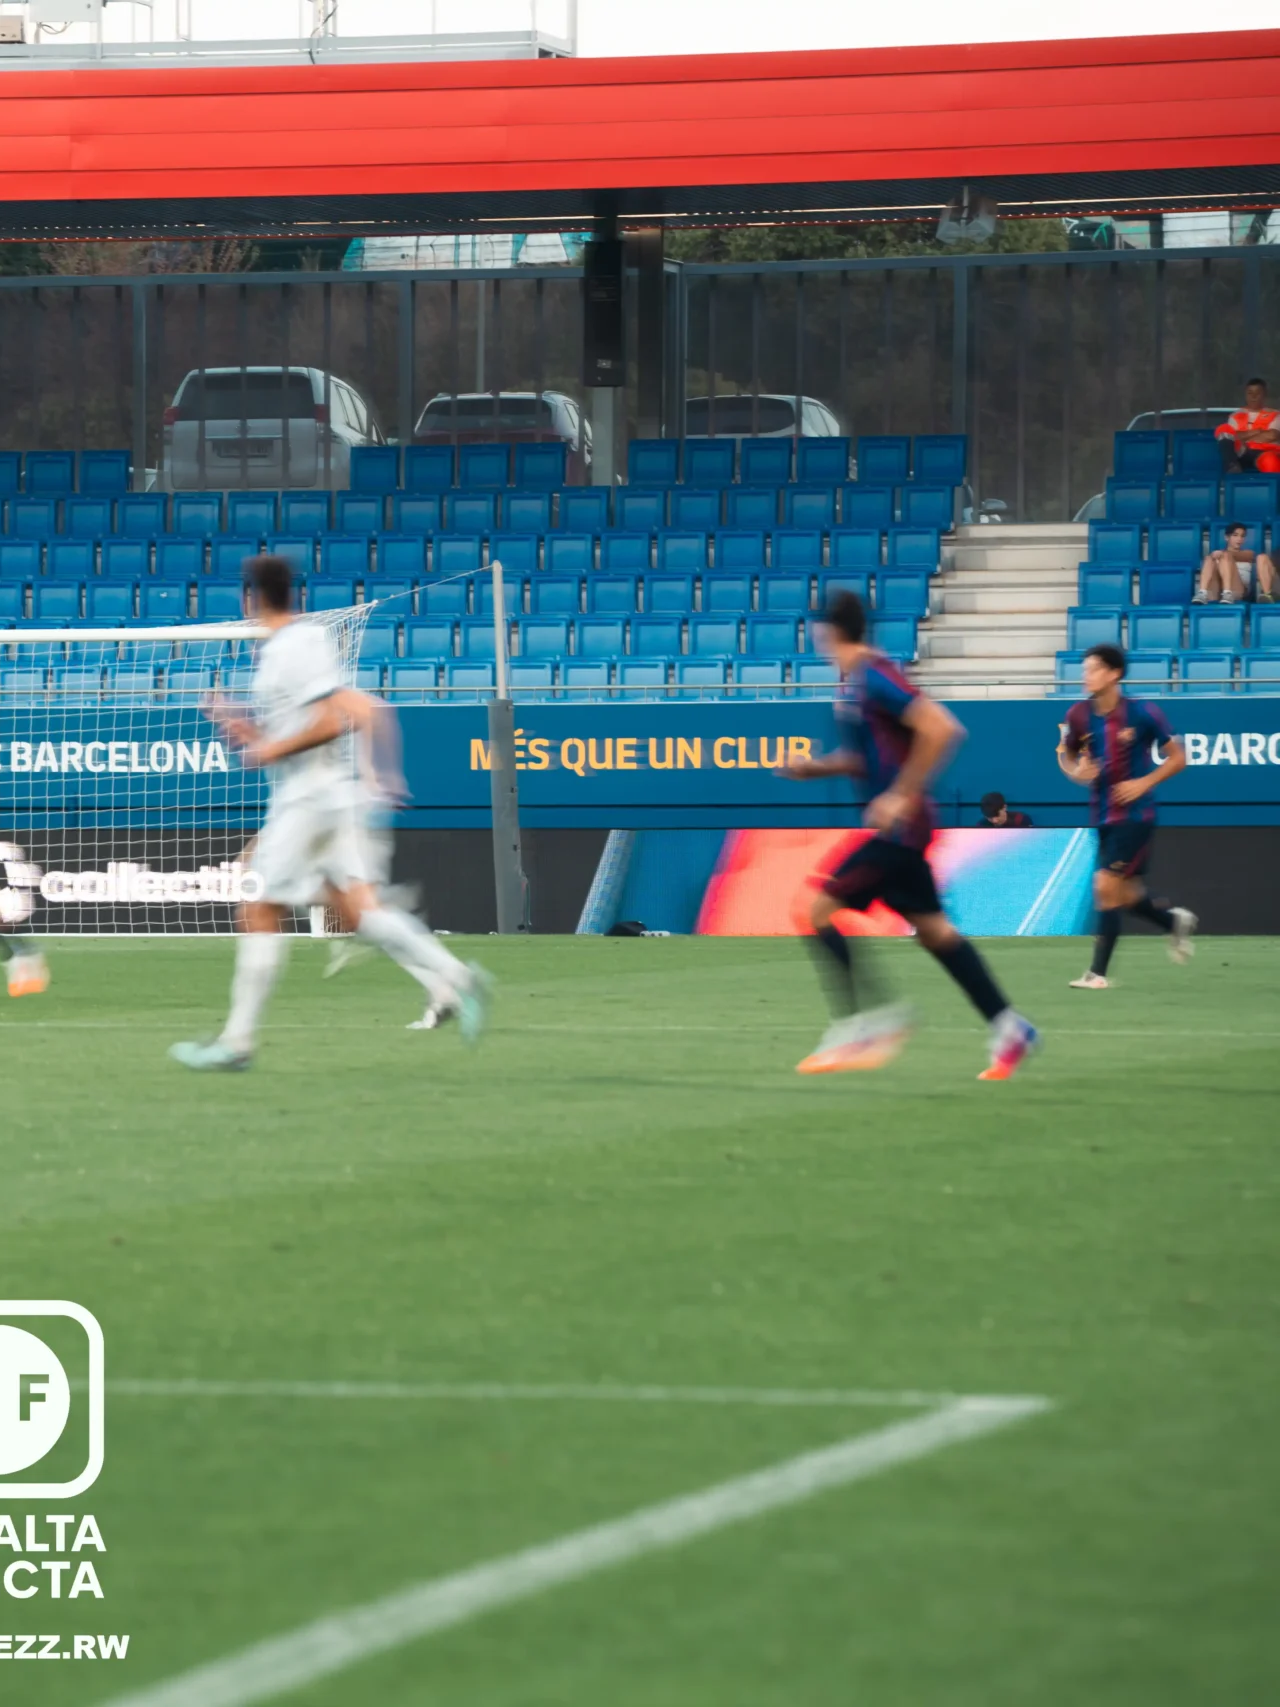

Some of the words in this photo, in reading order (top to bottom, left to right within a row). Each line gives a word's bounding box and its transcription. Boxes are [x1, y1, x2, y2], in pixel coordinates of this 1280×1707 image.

[10, 740, 228, 773] BARCELONA
[560, 737, 637, 777] QUE
[649, 737, 701, 769] UN
[713, 736, 812, 769] CLUB
